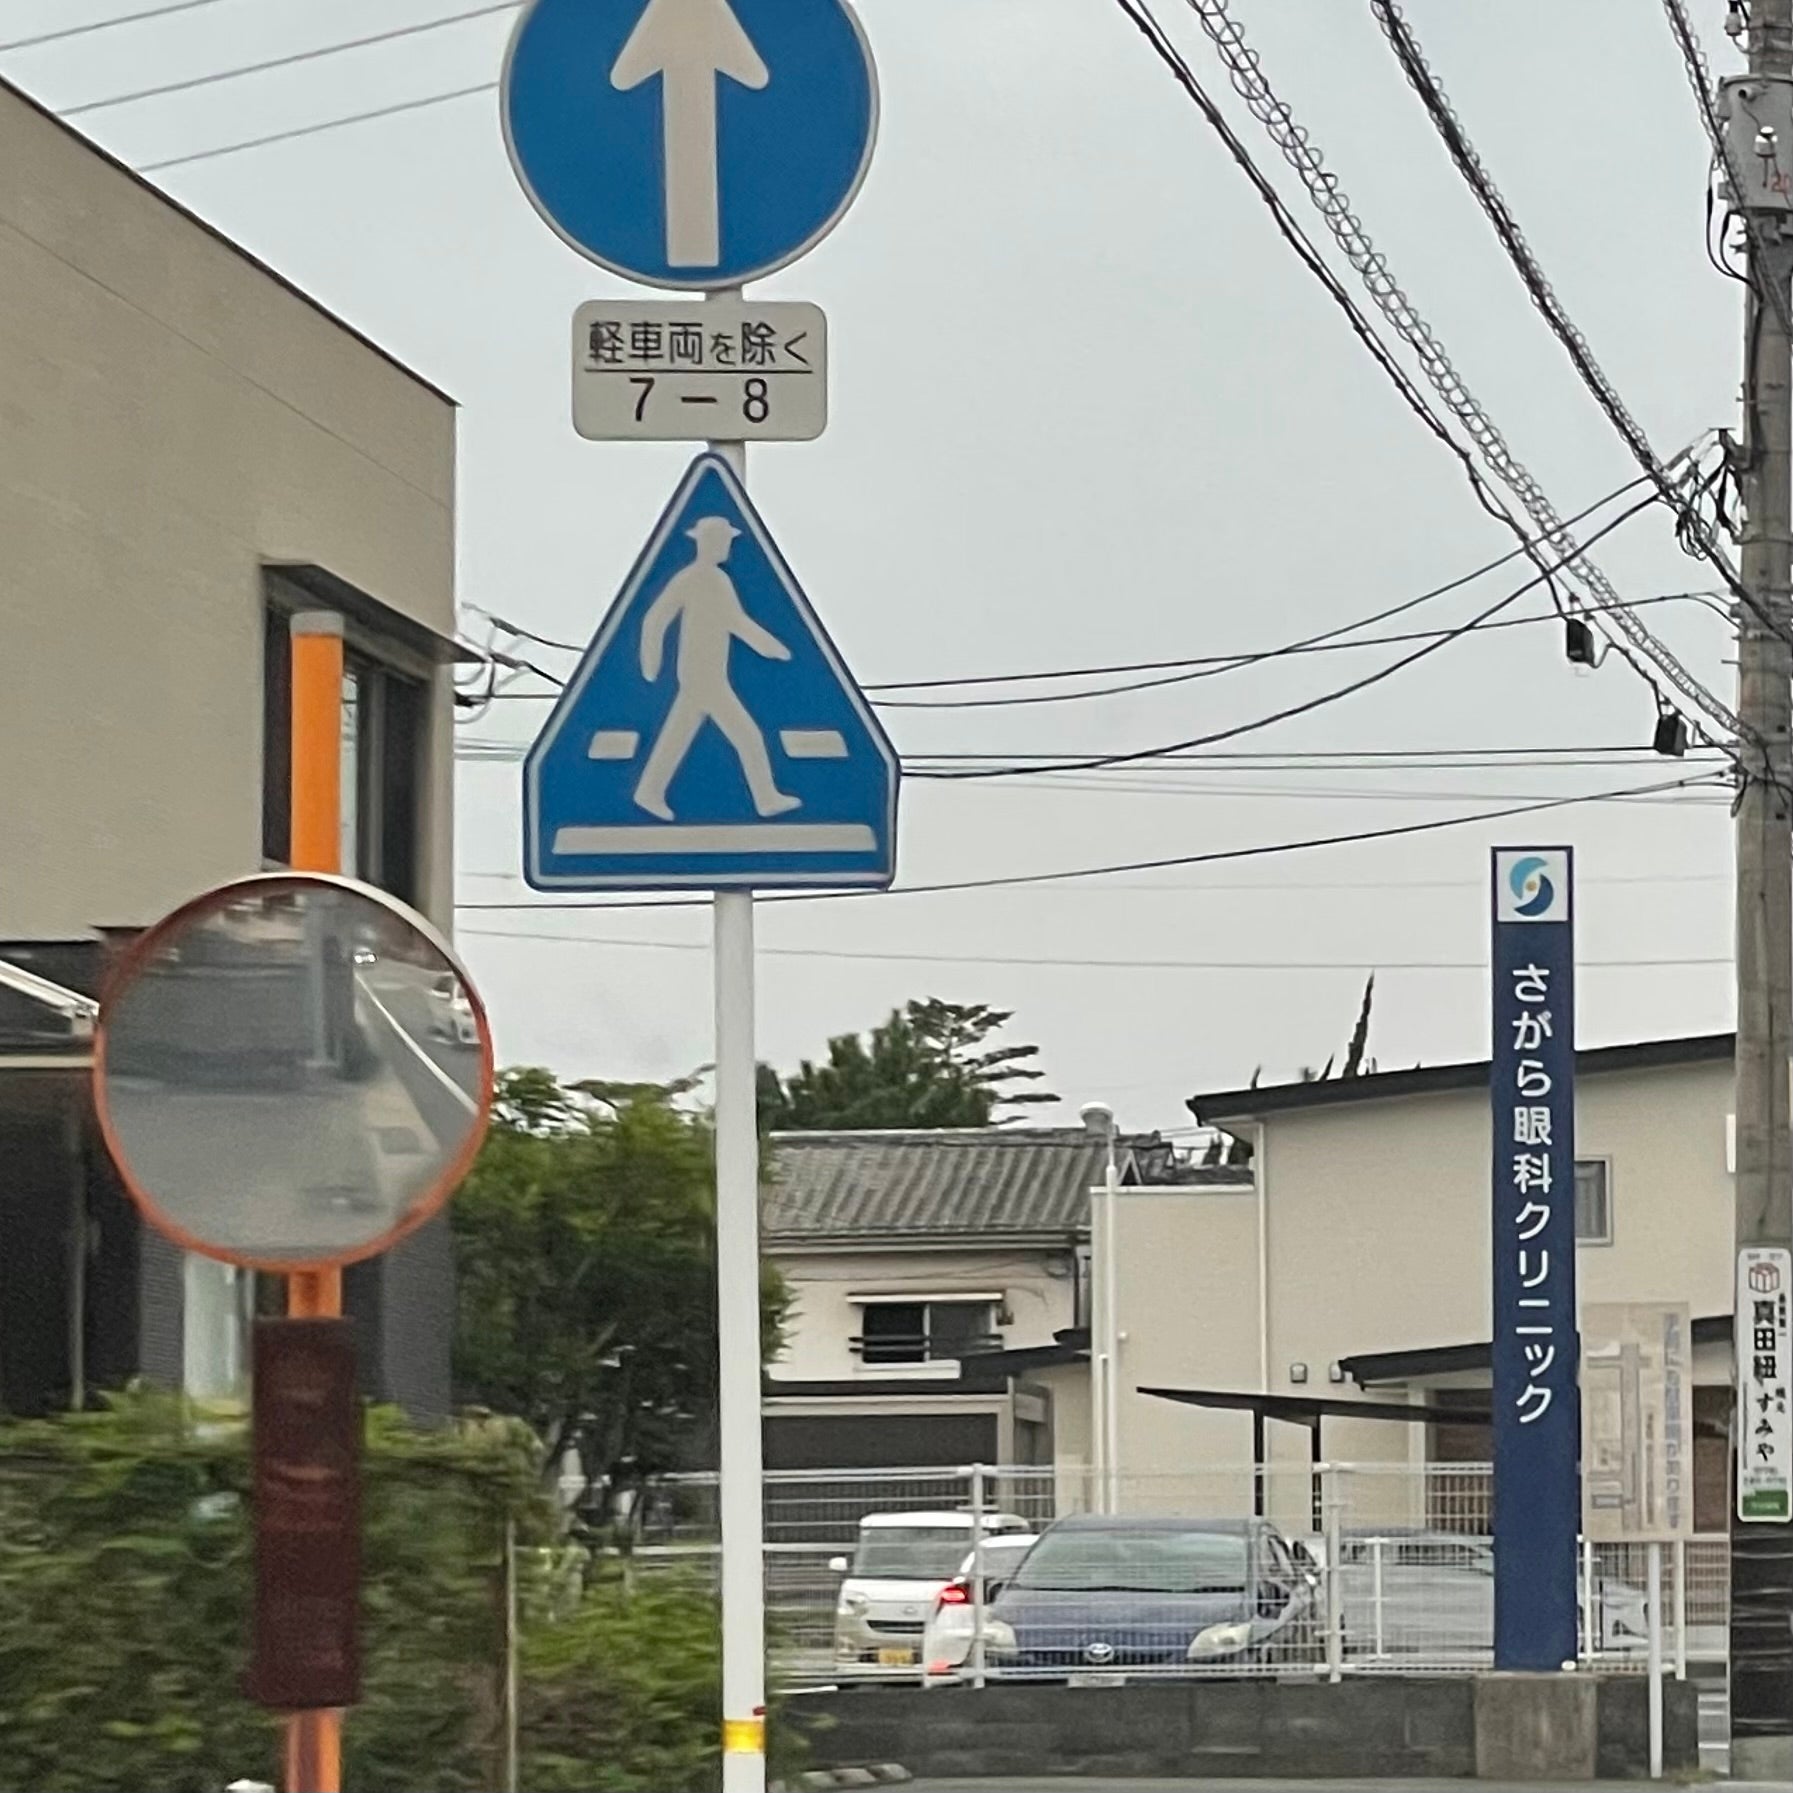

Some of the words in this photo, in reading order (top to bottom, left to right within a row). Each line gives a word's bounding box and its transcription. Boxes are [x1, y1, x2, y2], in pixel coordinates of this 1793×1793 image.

[588, 320, 809, 366] 軽車両を除く
[1512, 963, 1555, 1424] さがら眼科クリニック
